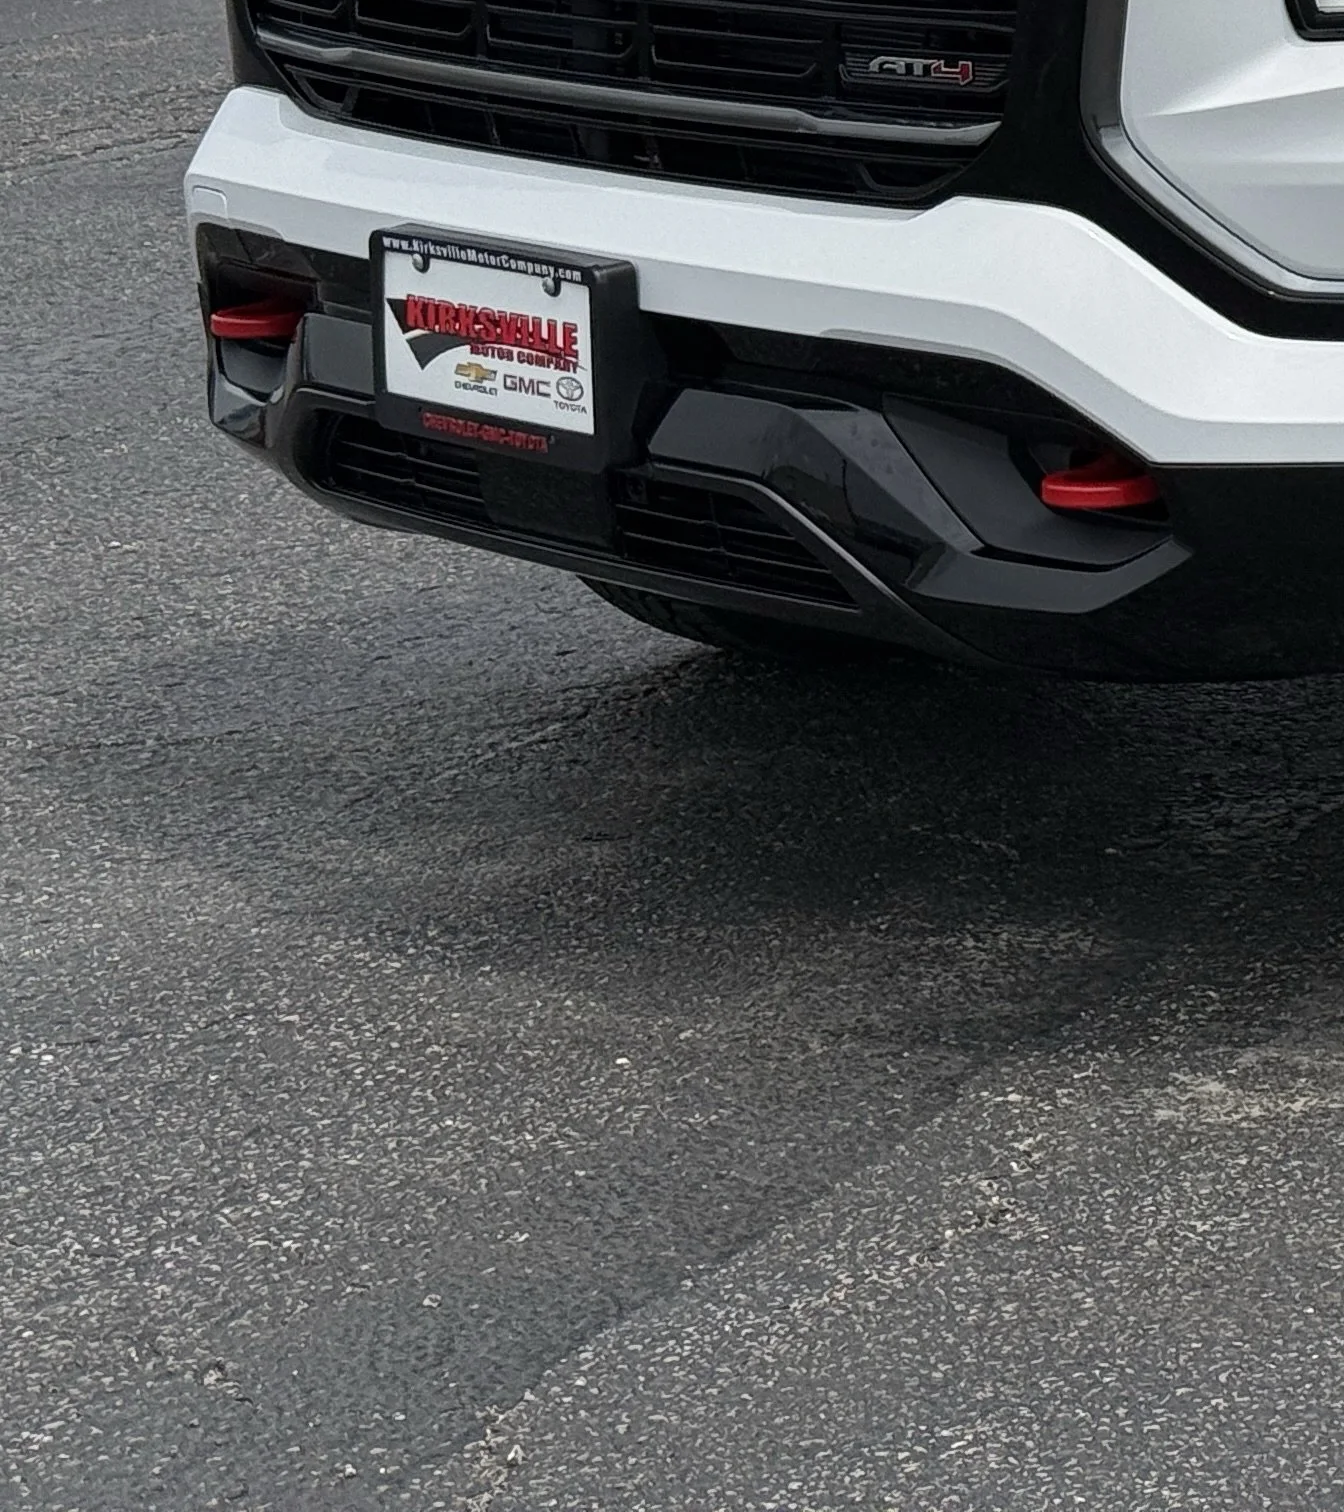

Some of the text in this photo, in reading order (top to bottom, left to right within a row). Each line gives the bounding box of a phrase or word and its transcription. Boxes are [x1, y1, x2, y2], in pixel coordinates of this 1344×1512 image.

[868, 55, 973, 85] AT4
[406, 294, 578, 359] KIRKSVILLE
[470, 344, 578, 374] MOTOR COMPANY
[503, 373, 551, 398] GMC
[554, 399, 587, 415] TOYOTA
